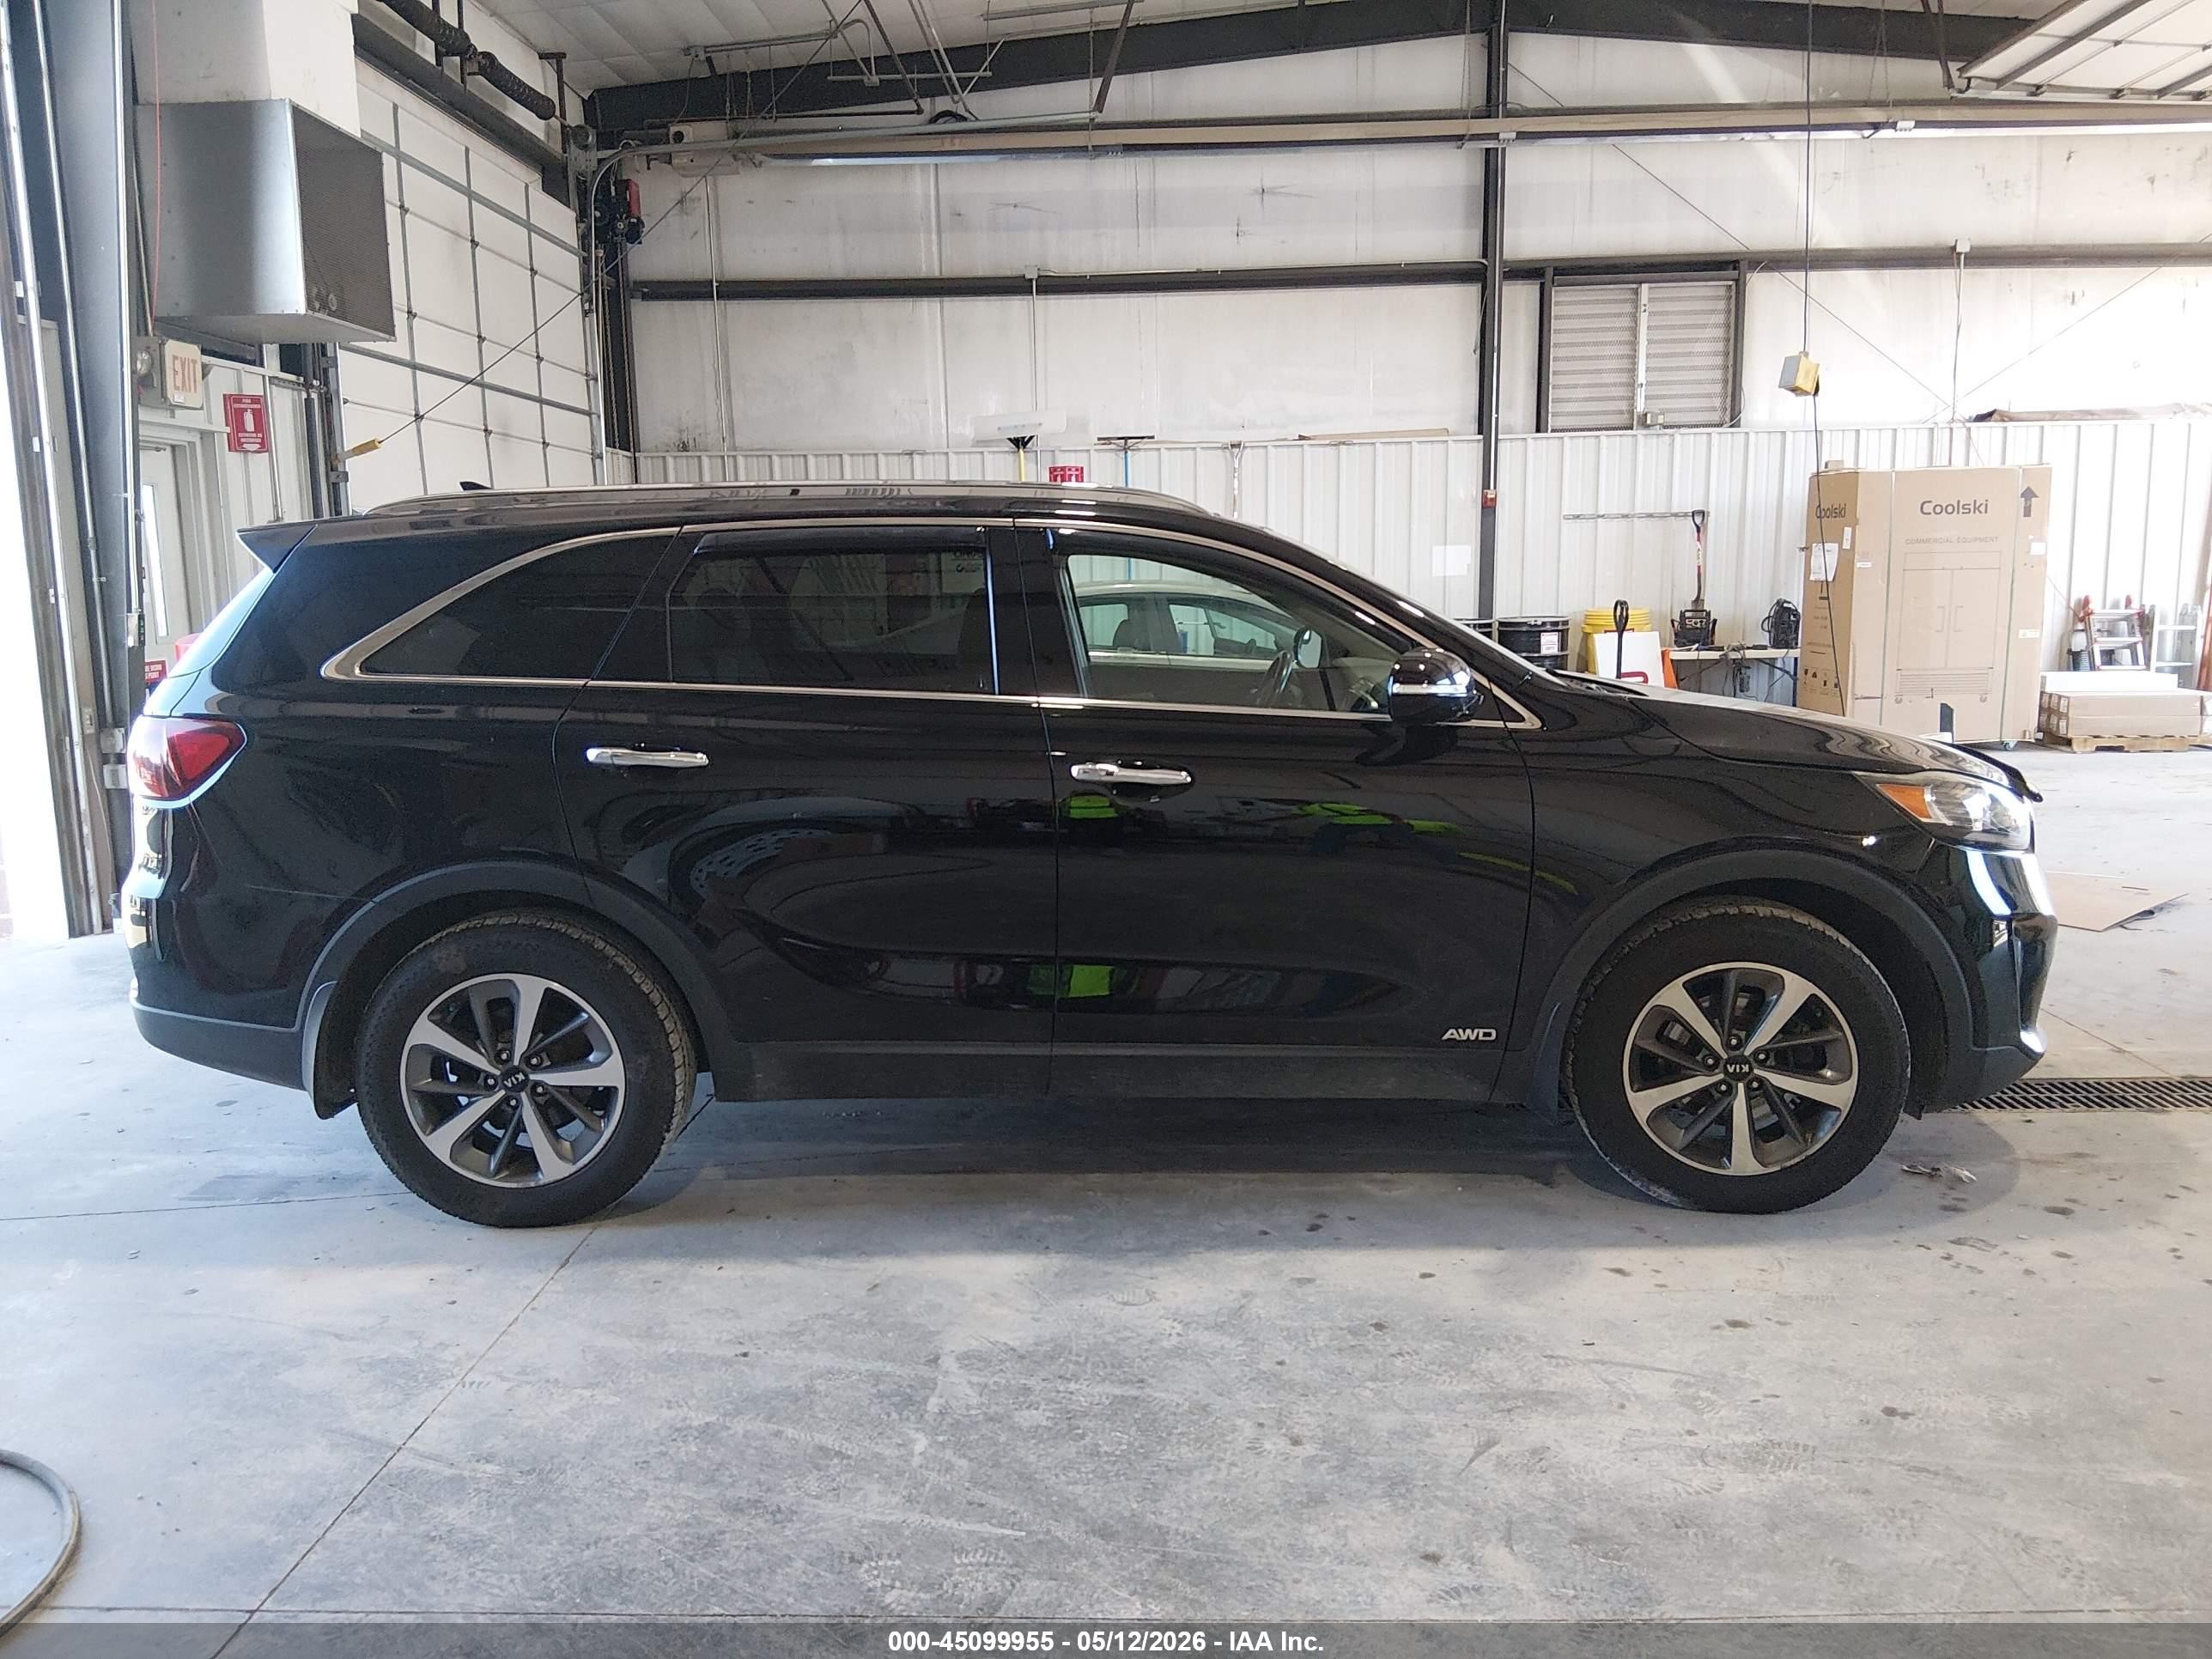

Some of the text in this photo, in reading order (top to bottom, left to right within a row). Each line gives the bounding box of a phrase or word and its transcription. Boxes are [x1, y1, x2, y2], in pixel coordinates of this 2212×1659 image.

[173, 355, 197, 392] EXIT
[1815, 502, 1846, 519] Coolski
[1920, 499, 1990, 515] Coolski
[1905, 537, 1954, 545] COMMERCIAL
[1441, 1028, 1497, 1041] AWD
[1726, 1064, 1750, 1073] KIA
